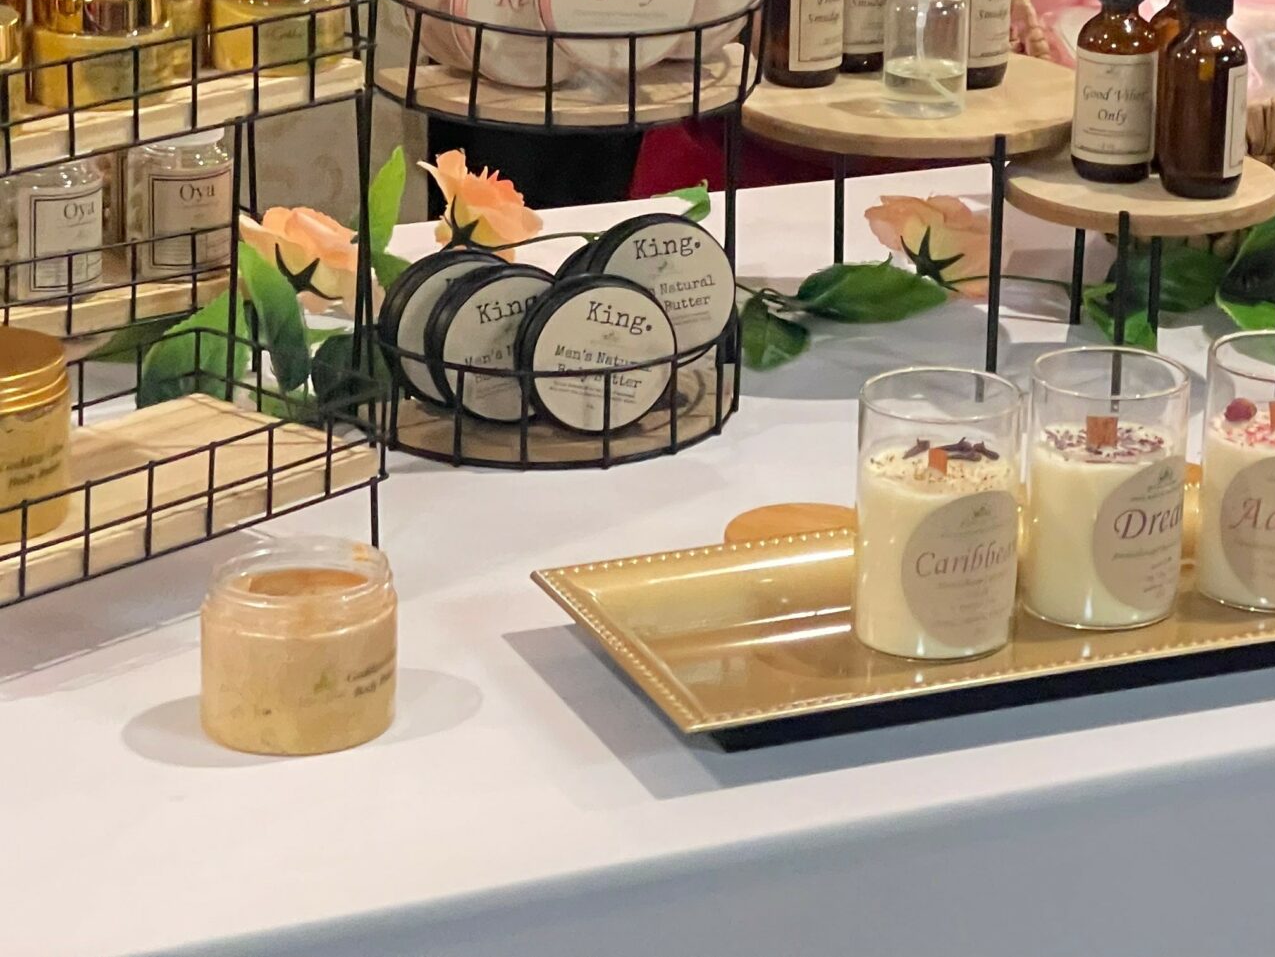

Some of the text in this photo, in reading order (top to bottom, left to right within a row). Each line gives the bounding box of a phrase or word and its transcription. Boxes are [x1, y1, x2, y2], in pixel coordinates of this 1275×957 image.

[1083, 85, 1113, 101] Good
[1097, 108, 1128, 126] Only
[180, 183, 216, 203] Oya
[63, 200, 95, 223] Oya
[633, 236, 701, 261] King.
[660, 274, 716, 295] Natural
[664, 295, 711, 313] Butter
[586, 300, 653, 337] King.
[555, 344, 593, 362] Men's
[1113, 500, 1183, 541] Drea
